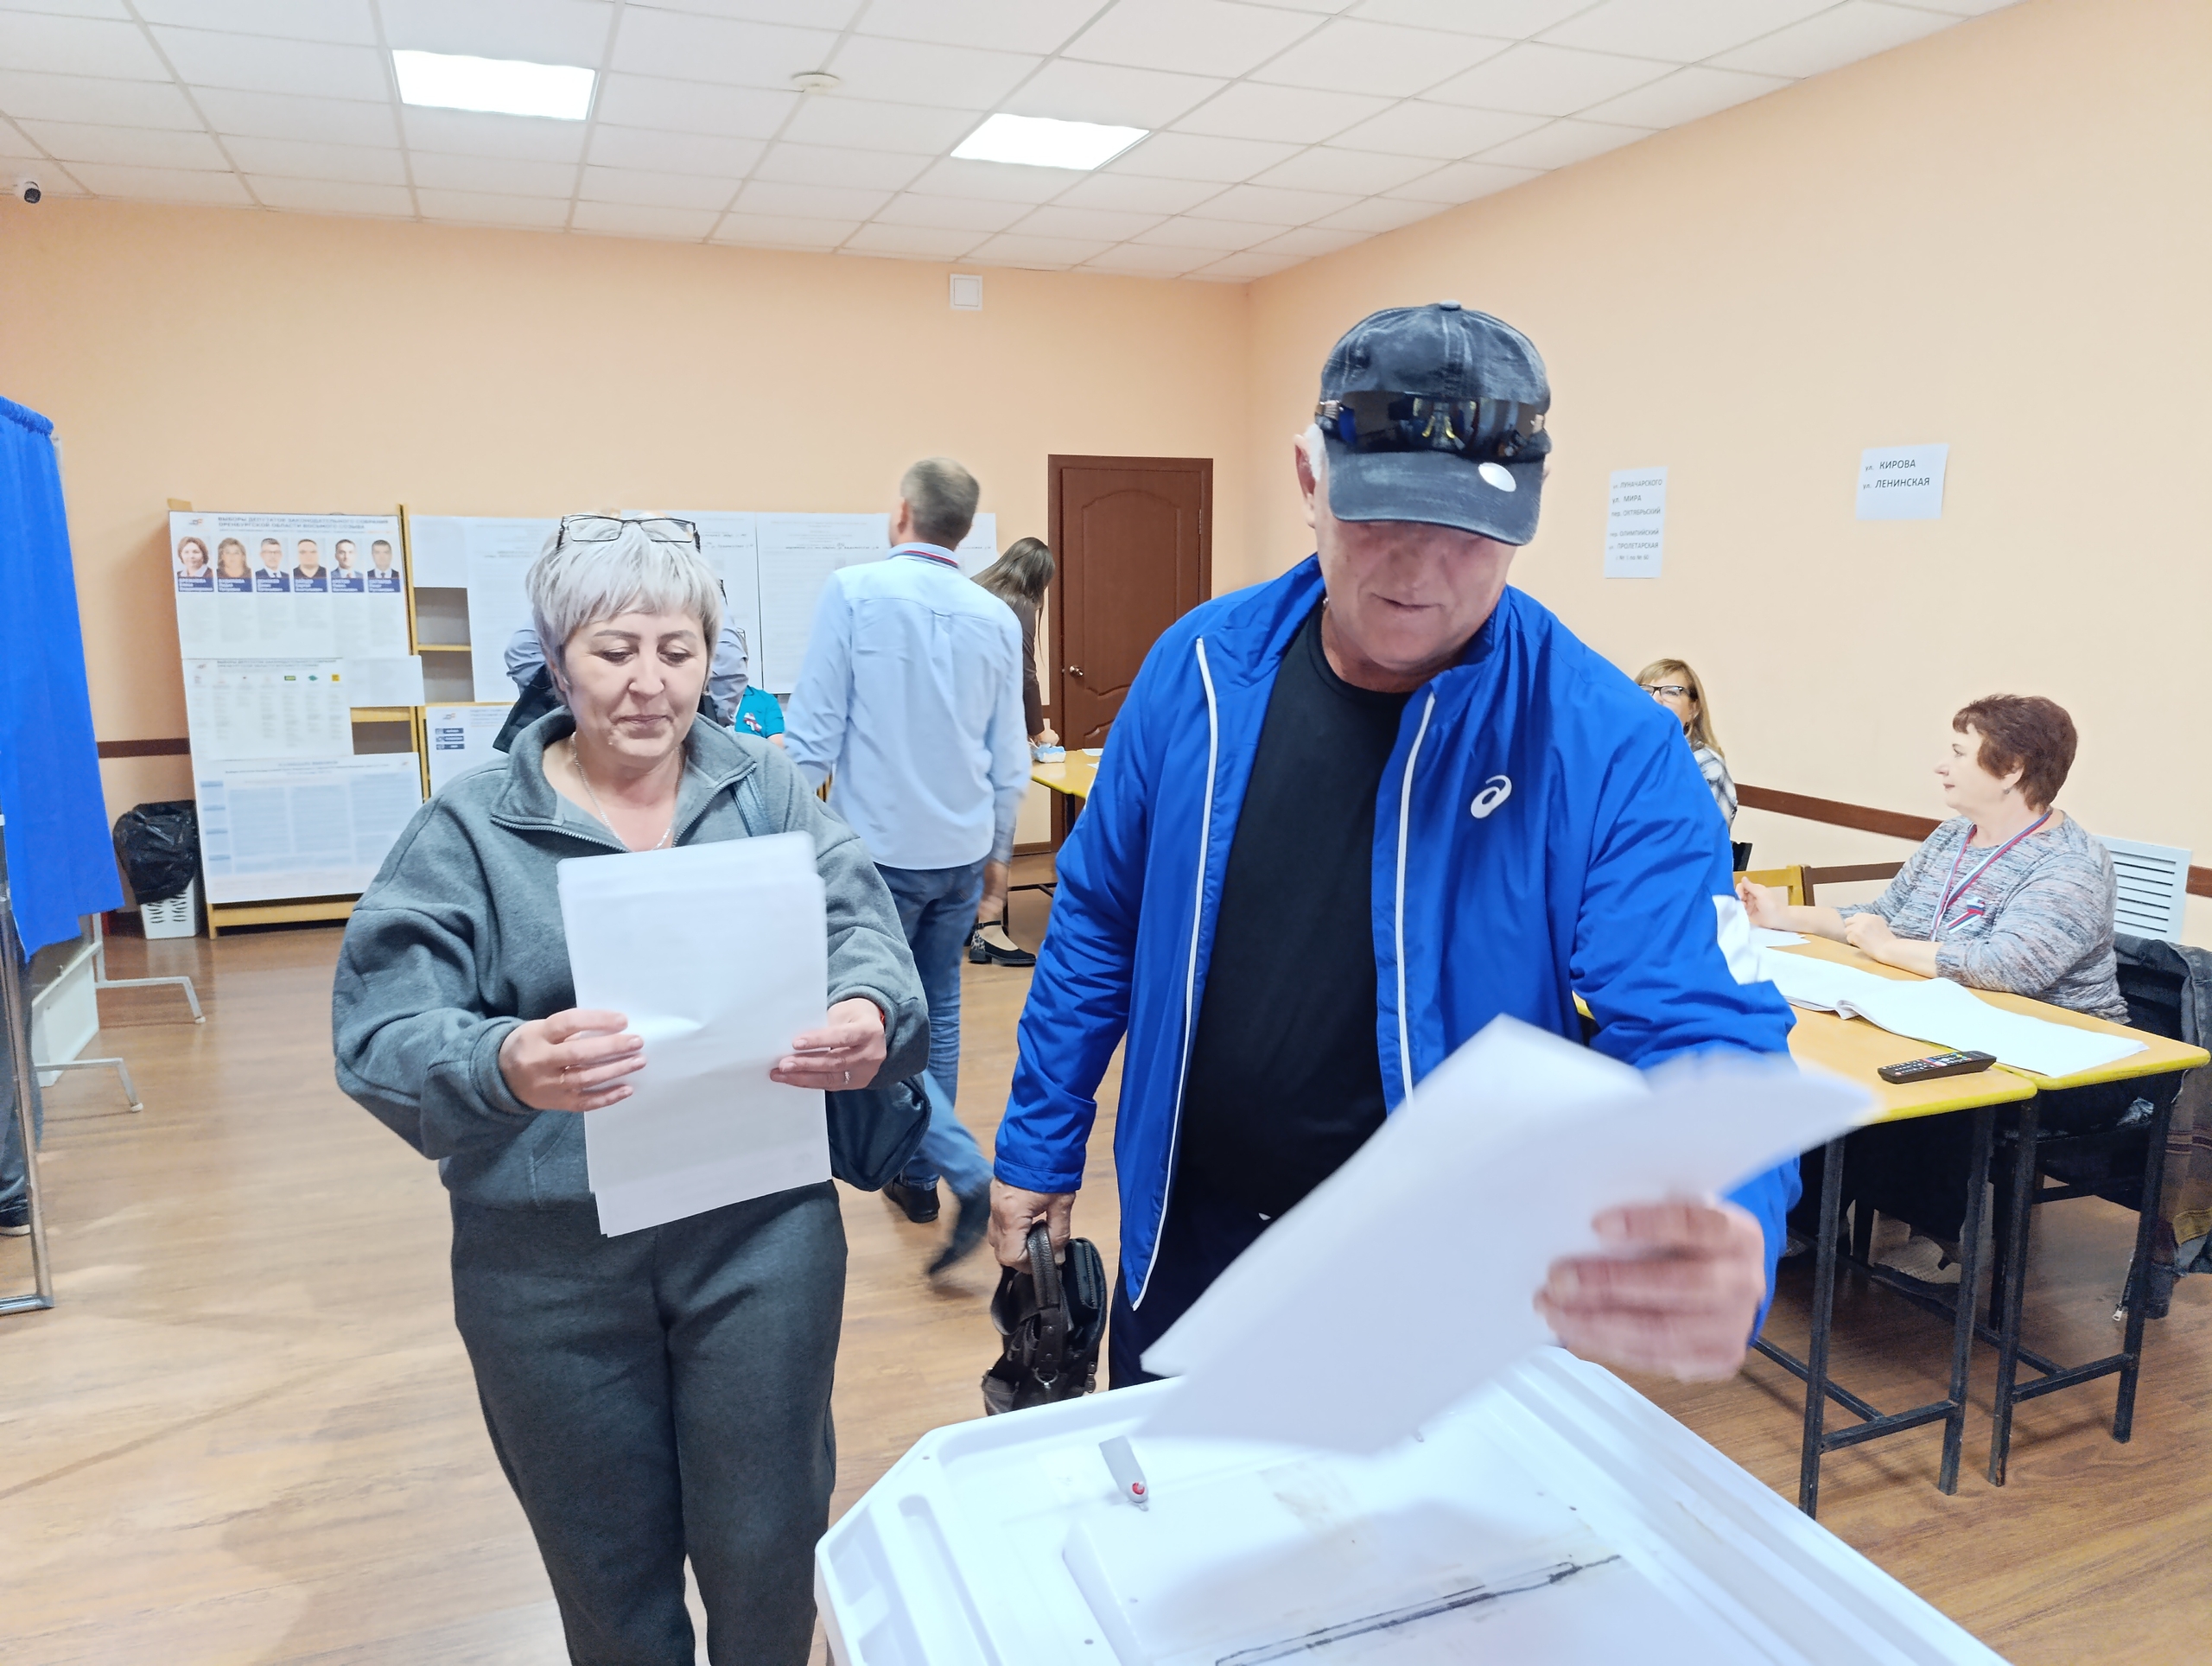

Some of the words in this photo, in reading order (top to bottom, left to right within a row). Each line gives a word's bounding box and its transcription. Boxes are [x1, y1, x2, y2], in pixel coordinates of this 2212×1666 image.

[1879, 459, 1916, 470] КИРОВА
[1619, 479, 1662, 489] ЛУНАЧАРСКОГО
[1875, 477, 1930, 488] ЛЕНИНСКАЯ
[1623, 506, 1661, 517] ОКТЯБРЬСКИЙ
[1619, 528, 1659, 537] ОЛИМПИЙСКИЙ
